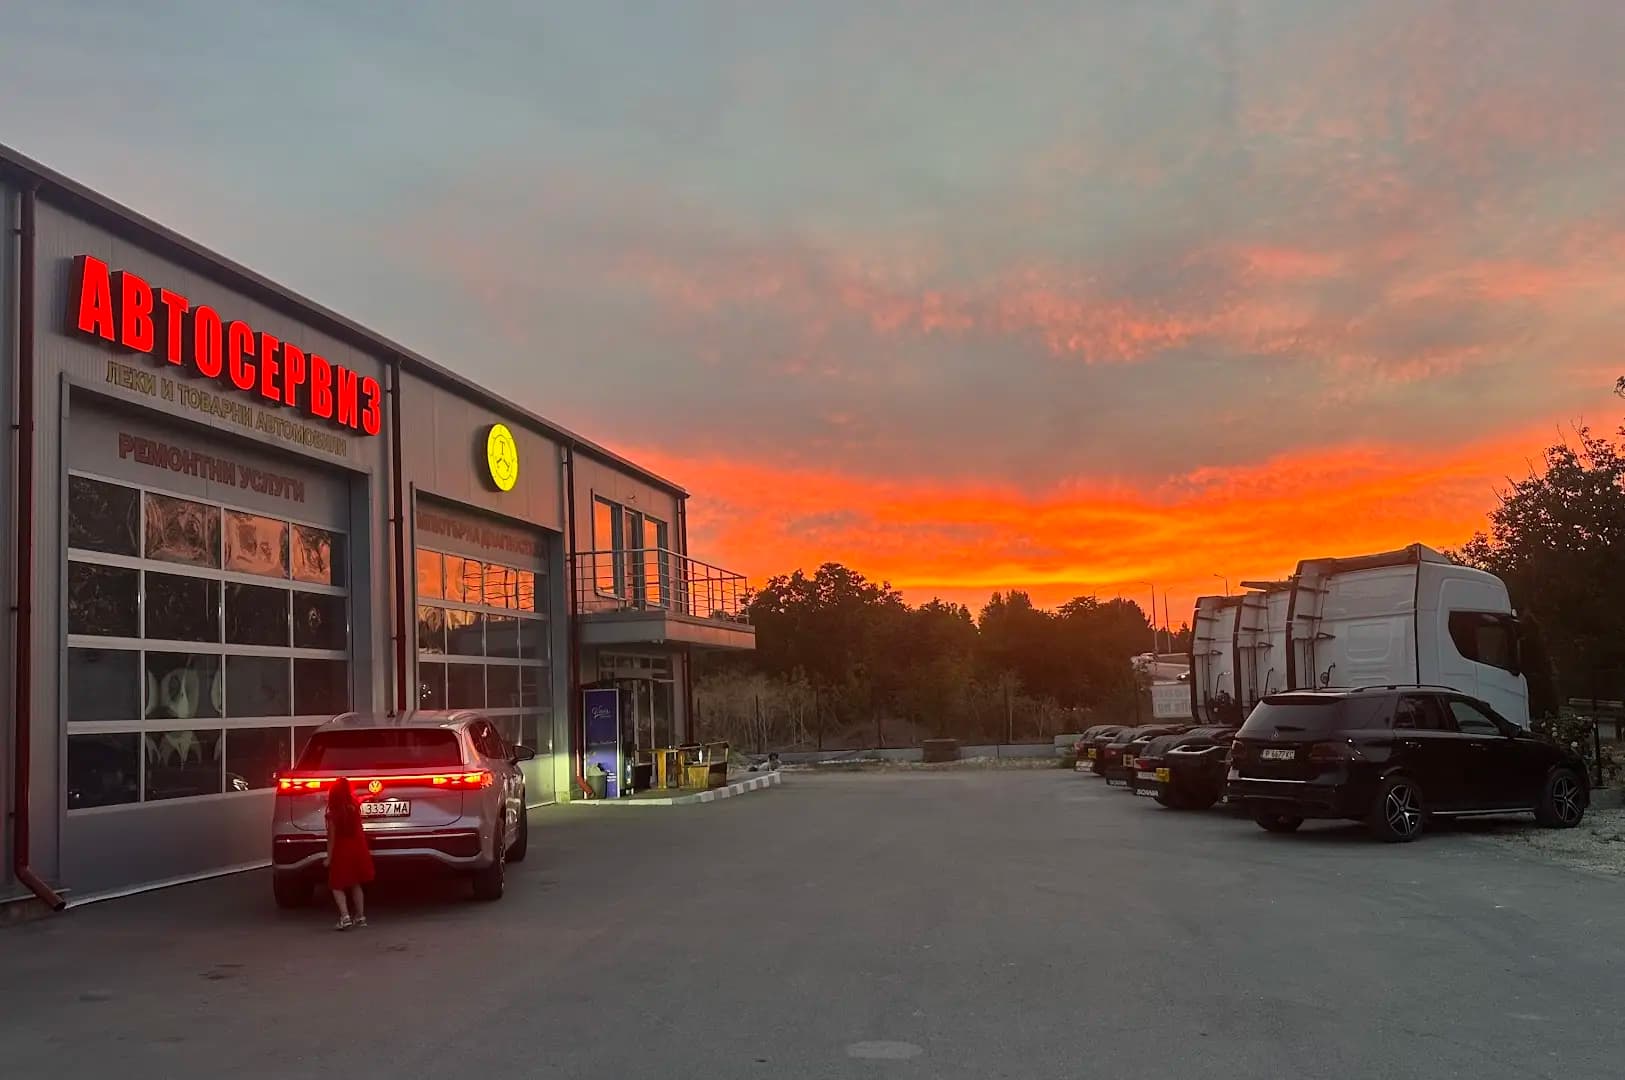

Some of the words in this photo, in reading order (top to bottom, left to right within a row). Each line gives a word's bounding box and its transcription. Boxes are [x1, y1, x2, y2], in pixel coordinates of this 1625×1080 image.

[75, 254, 382, 437] АВТОСЕРВИЗ
[105, 360, 157, 397] ЛЕКИ
[161, 377, 175, 402] И
[177, 383, 253, 428] ТОВАРНИ
[118, 432, 236, 488] РЕМОНТНИ
[238, 465, 305, 504] УСЛУГИ
[365, 803, 392, 815] 3337
[393, 802, 408, 814] MA
